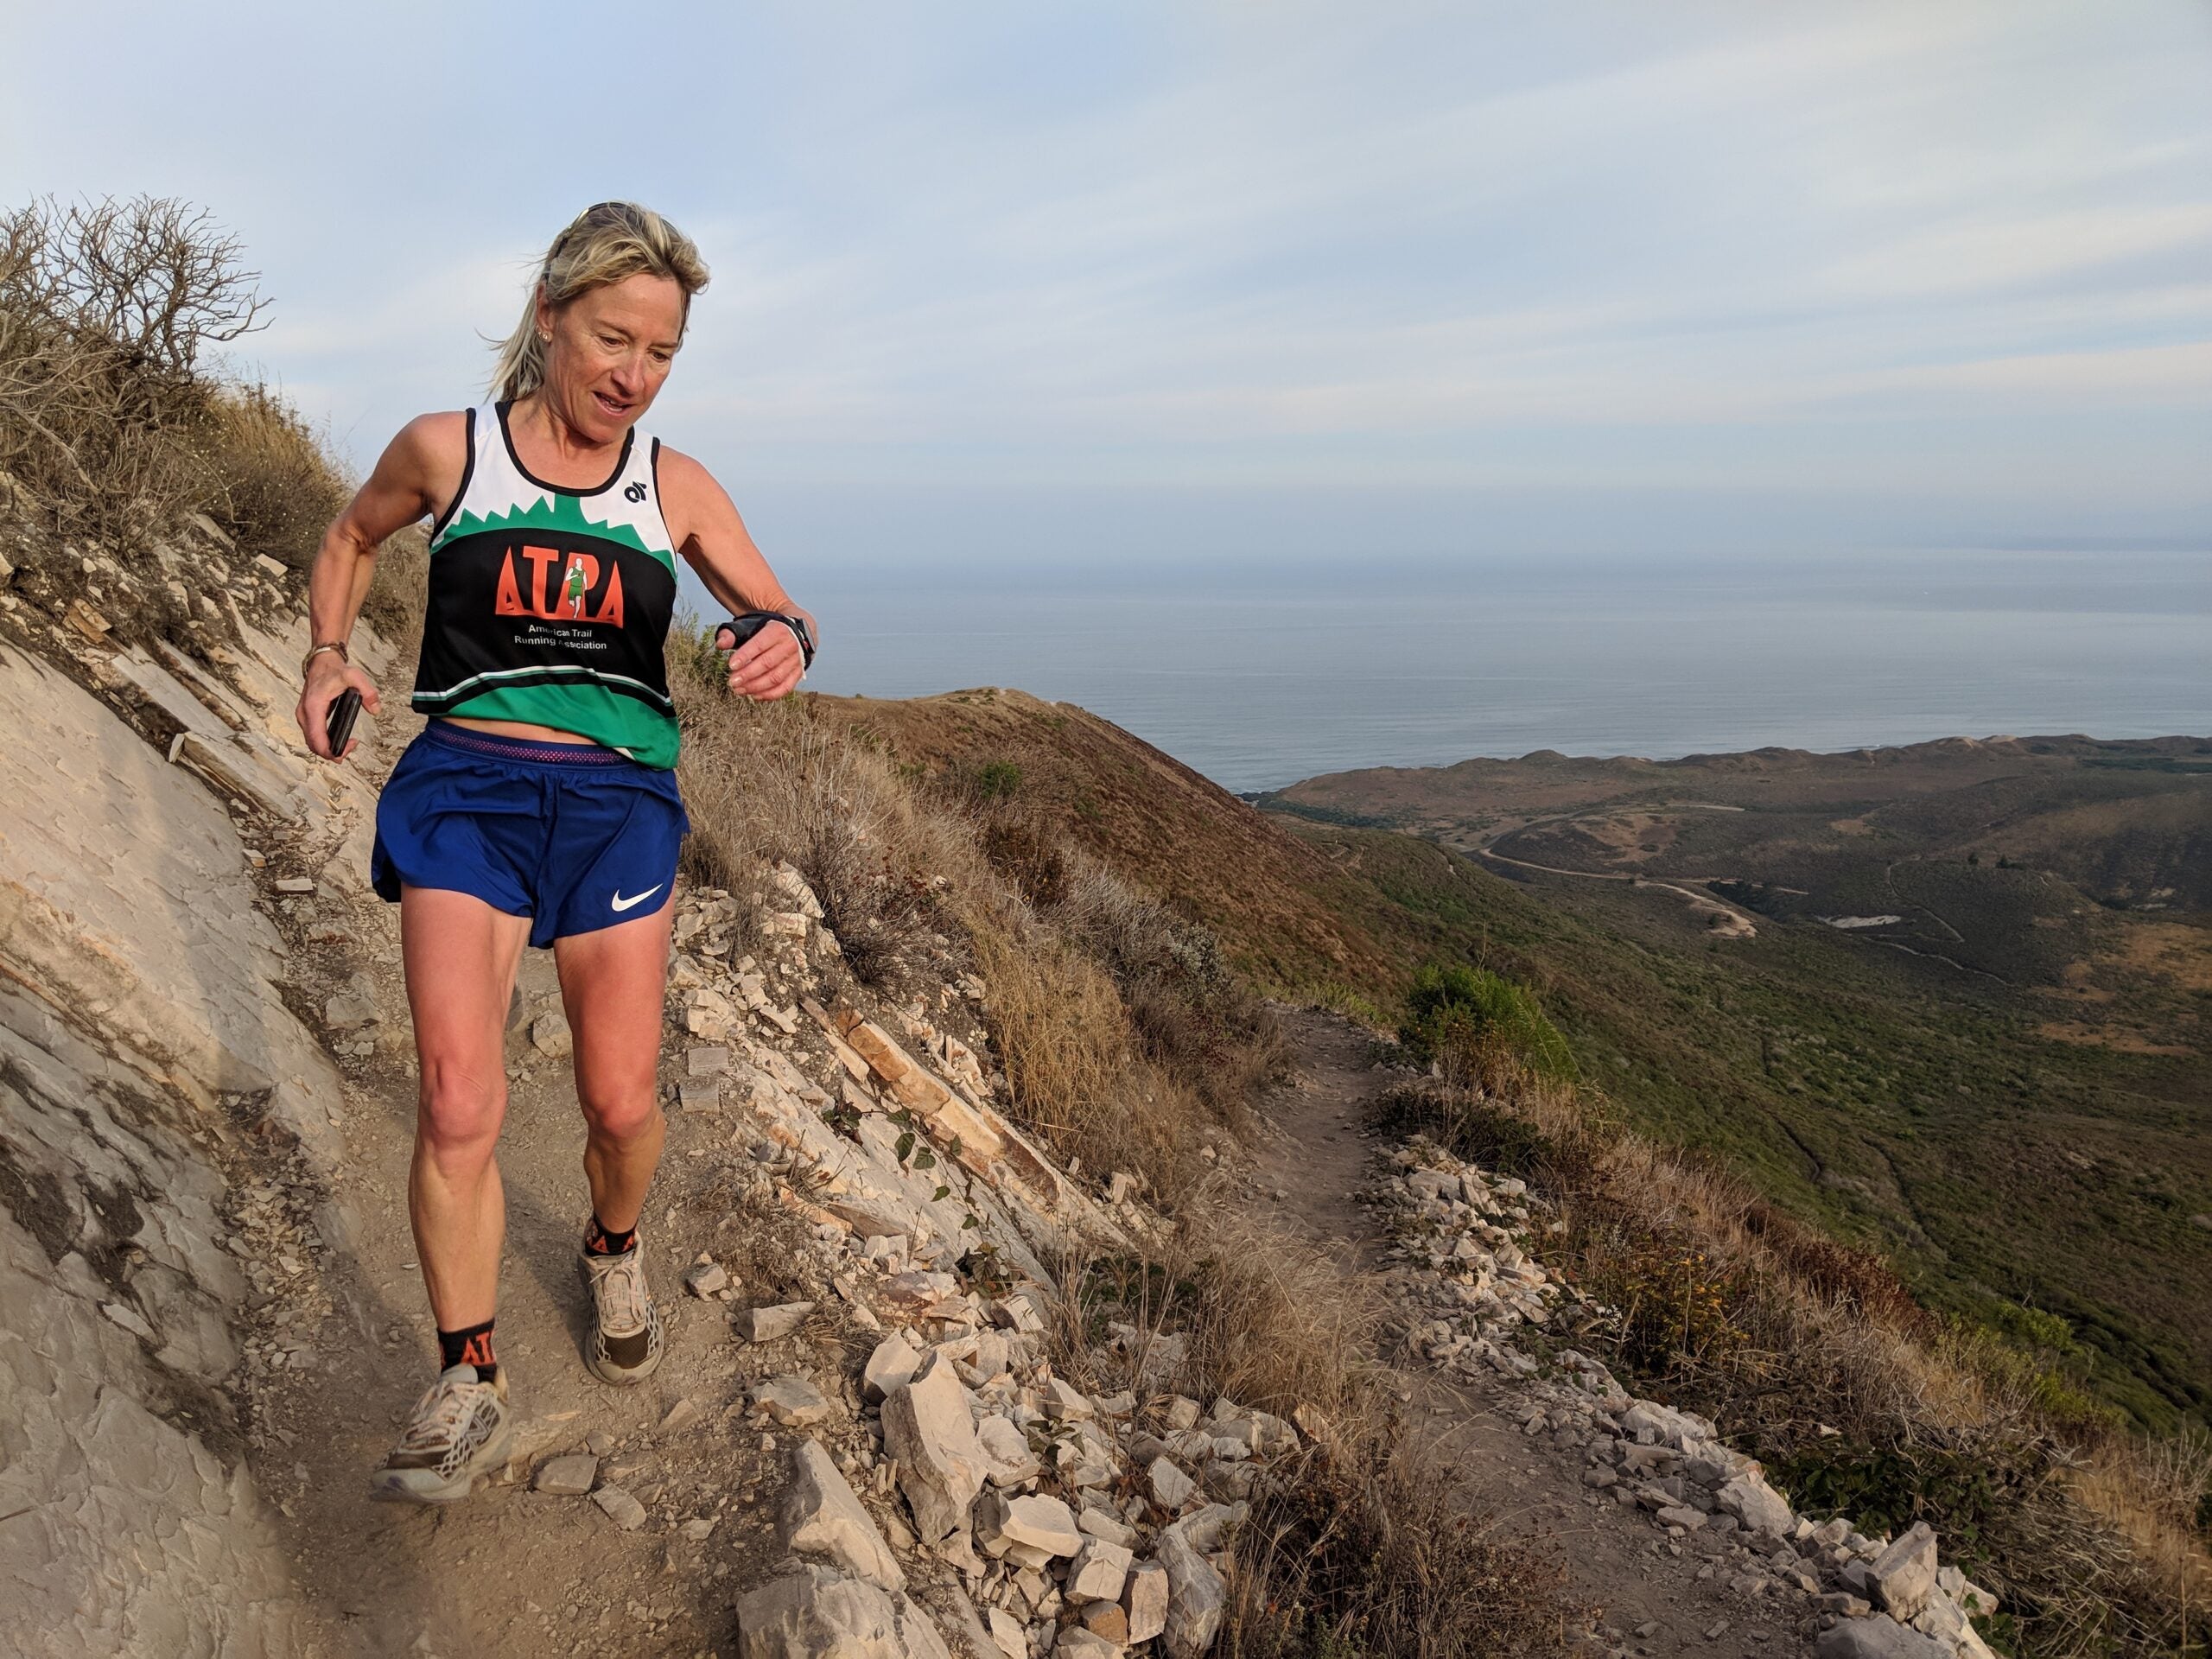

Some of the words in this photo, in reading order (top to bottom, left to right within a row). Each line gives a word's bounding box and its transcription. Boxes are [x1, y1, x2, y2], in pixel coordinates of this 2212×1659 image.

[495, 545, 624, 629] ATRA
[571, 629, 593, 639] Trail
[514, 635, 556, 646] Running
[558, 639, 607, 650] Assciation
